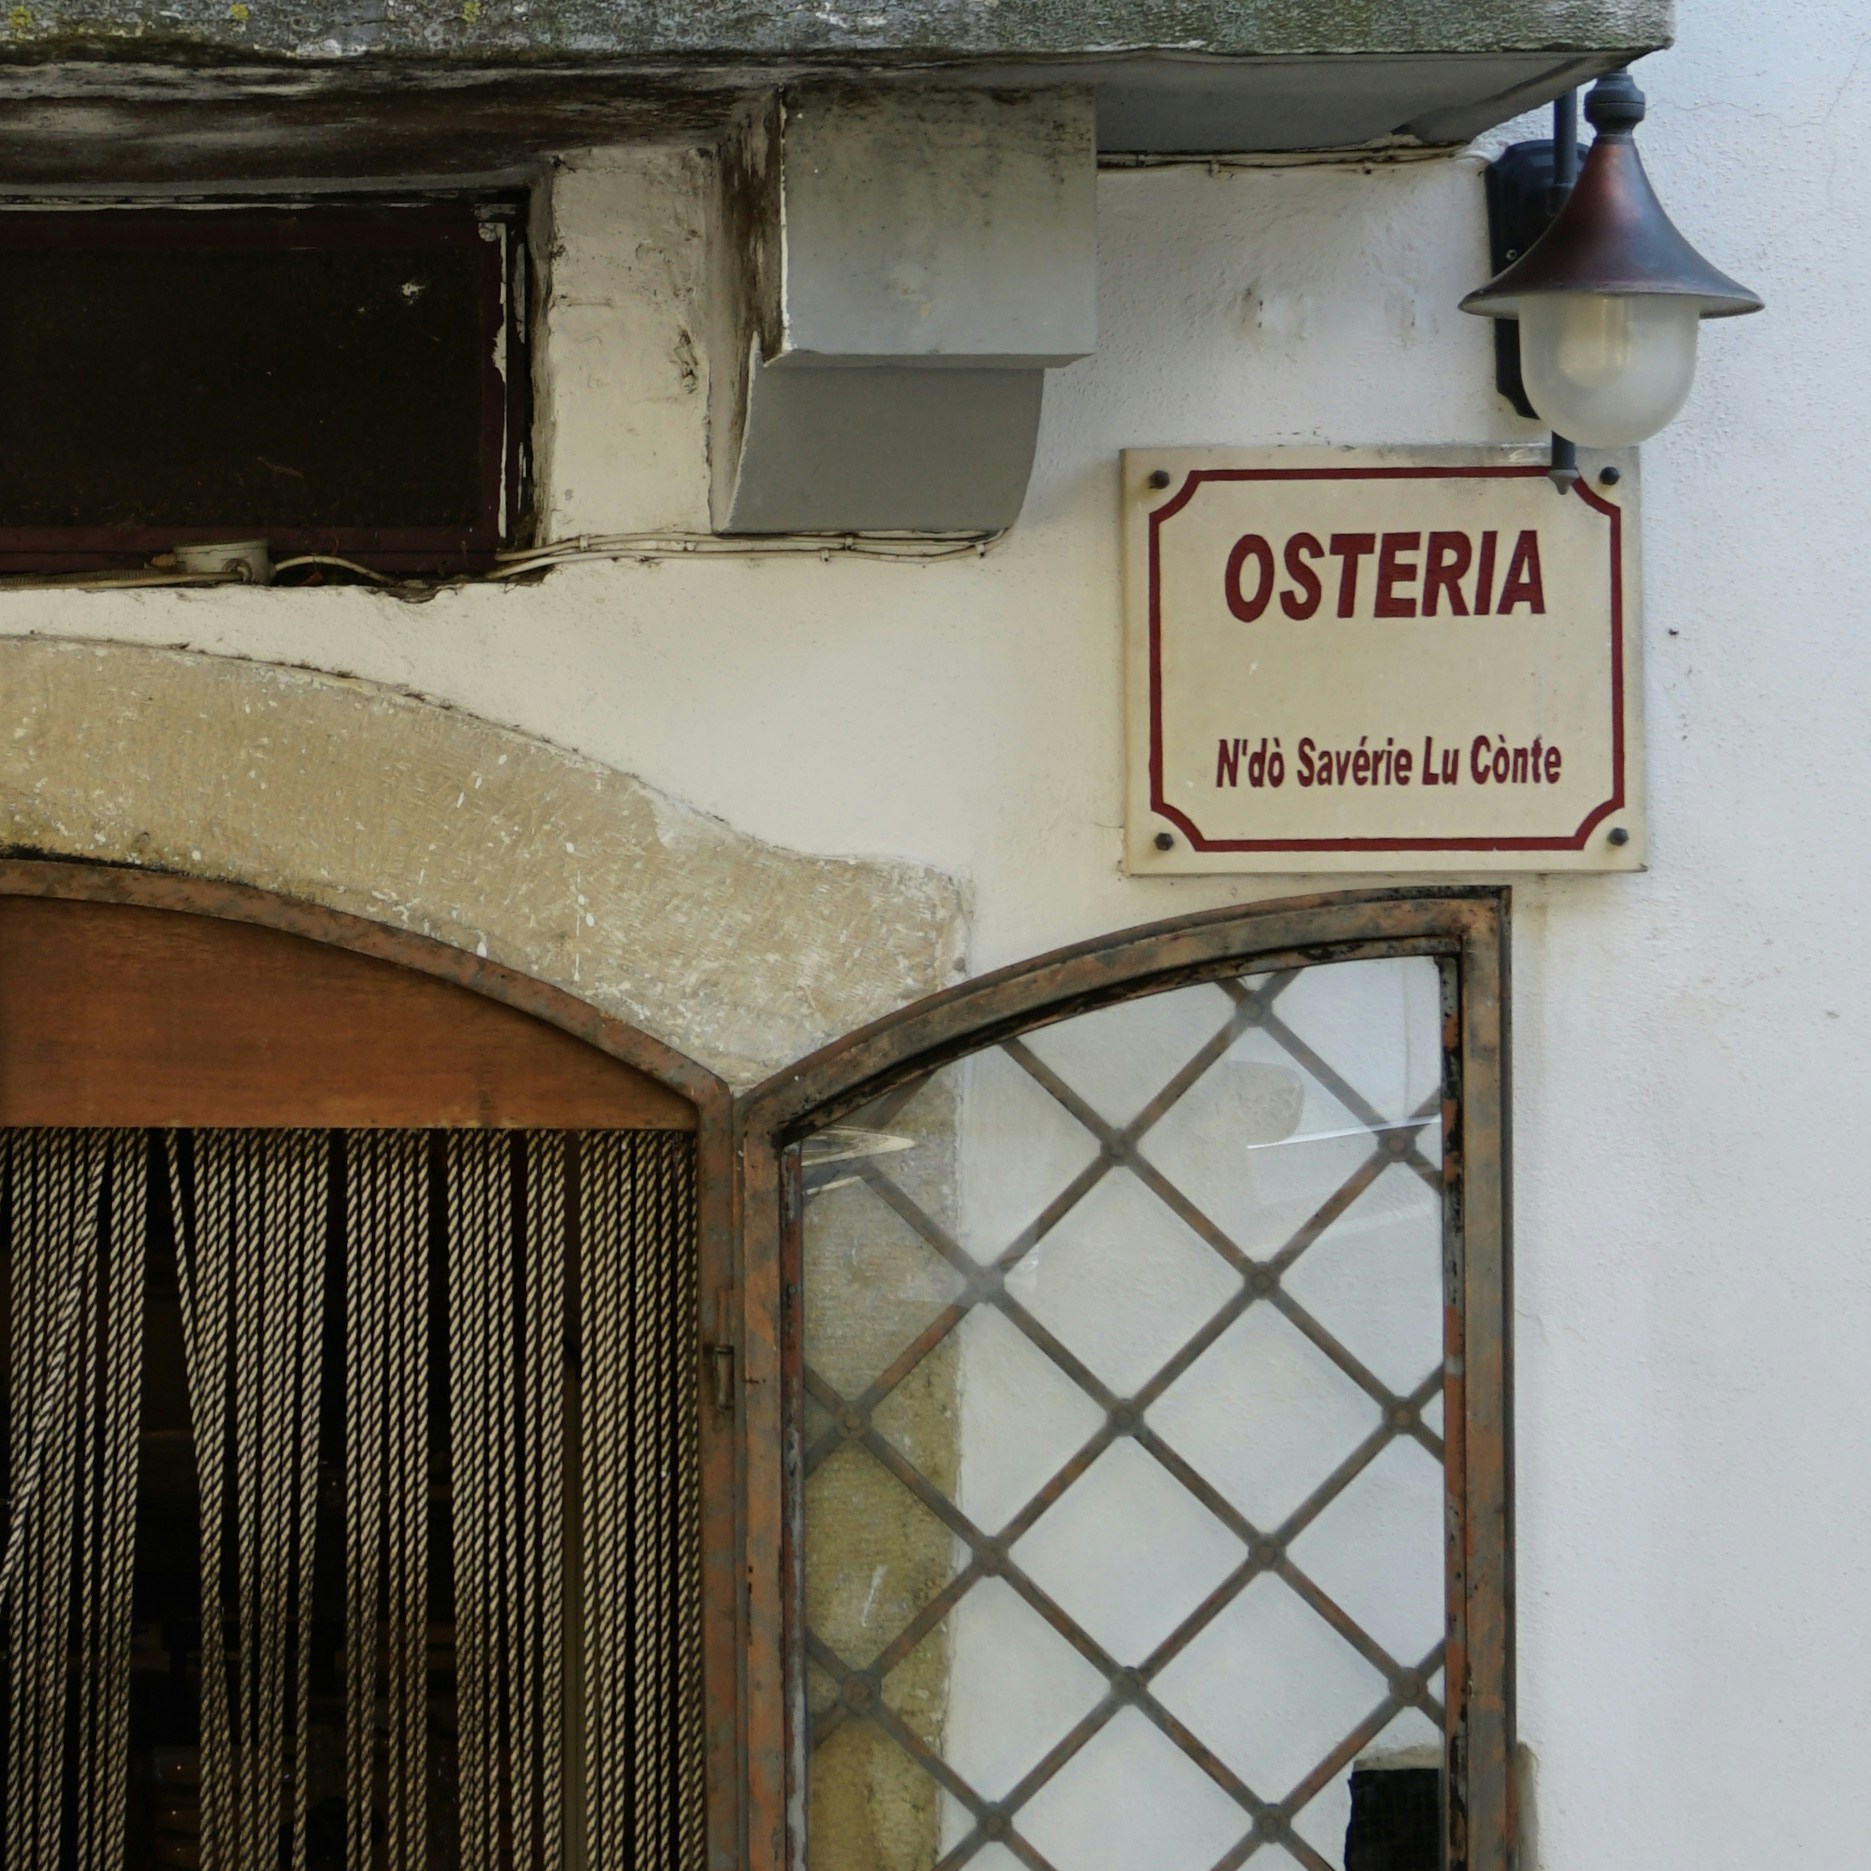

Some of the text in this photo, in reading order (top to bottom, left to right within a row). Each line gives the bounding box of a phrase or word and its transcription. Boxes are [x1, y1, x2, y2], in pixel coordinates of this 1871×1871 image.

[1224, 529, 1547, 624] OSTERIA
[1216, 733, 1563, 789] N'dò Savérie Lu Cònte
